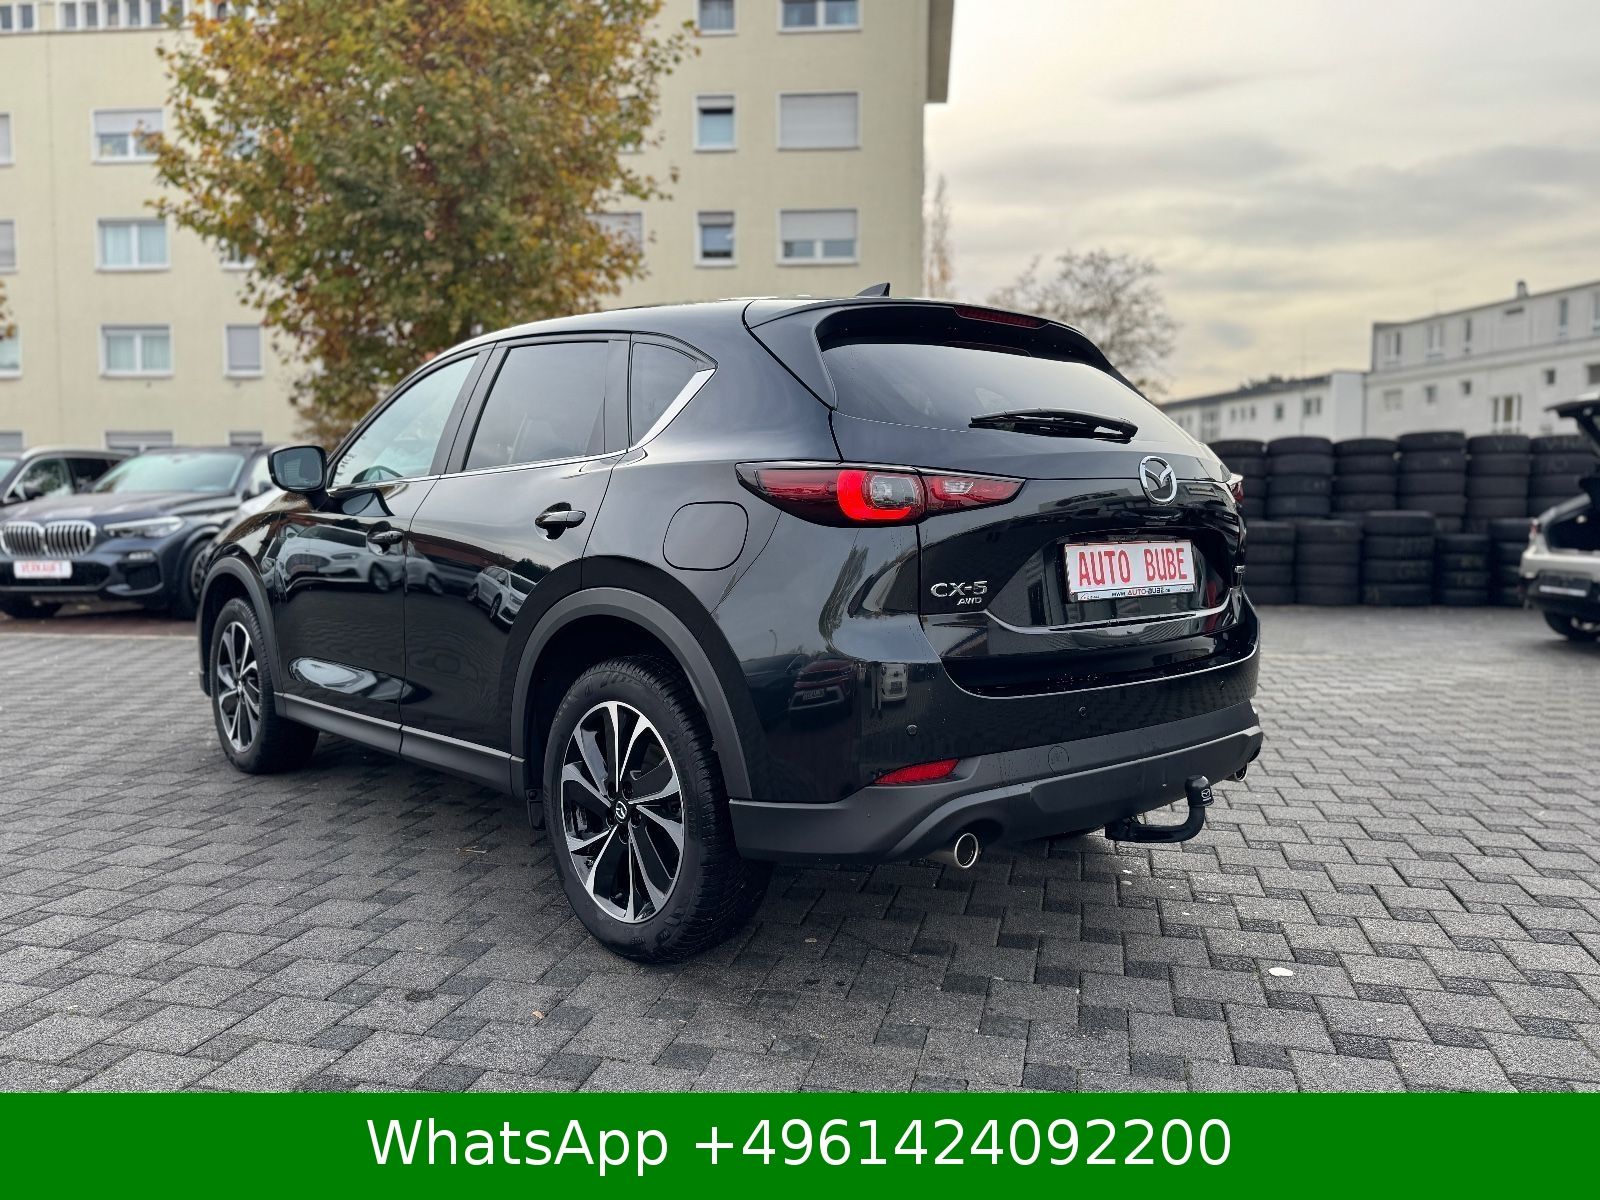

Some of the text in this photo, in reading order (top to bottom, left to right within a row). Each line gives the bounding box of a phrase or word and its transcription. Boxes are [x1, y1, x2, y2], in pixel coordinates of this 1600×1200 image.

[1078, 547, 1188, 586] AUTO BUBE
[930, 580, 988, 598] CX-5
[956, 597, 983, 606] AWD
